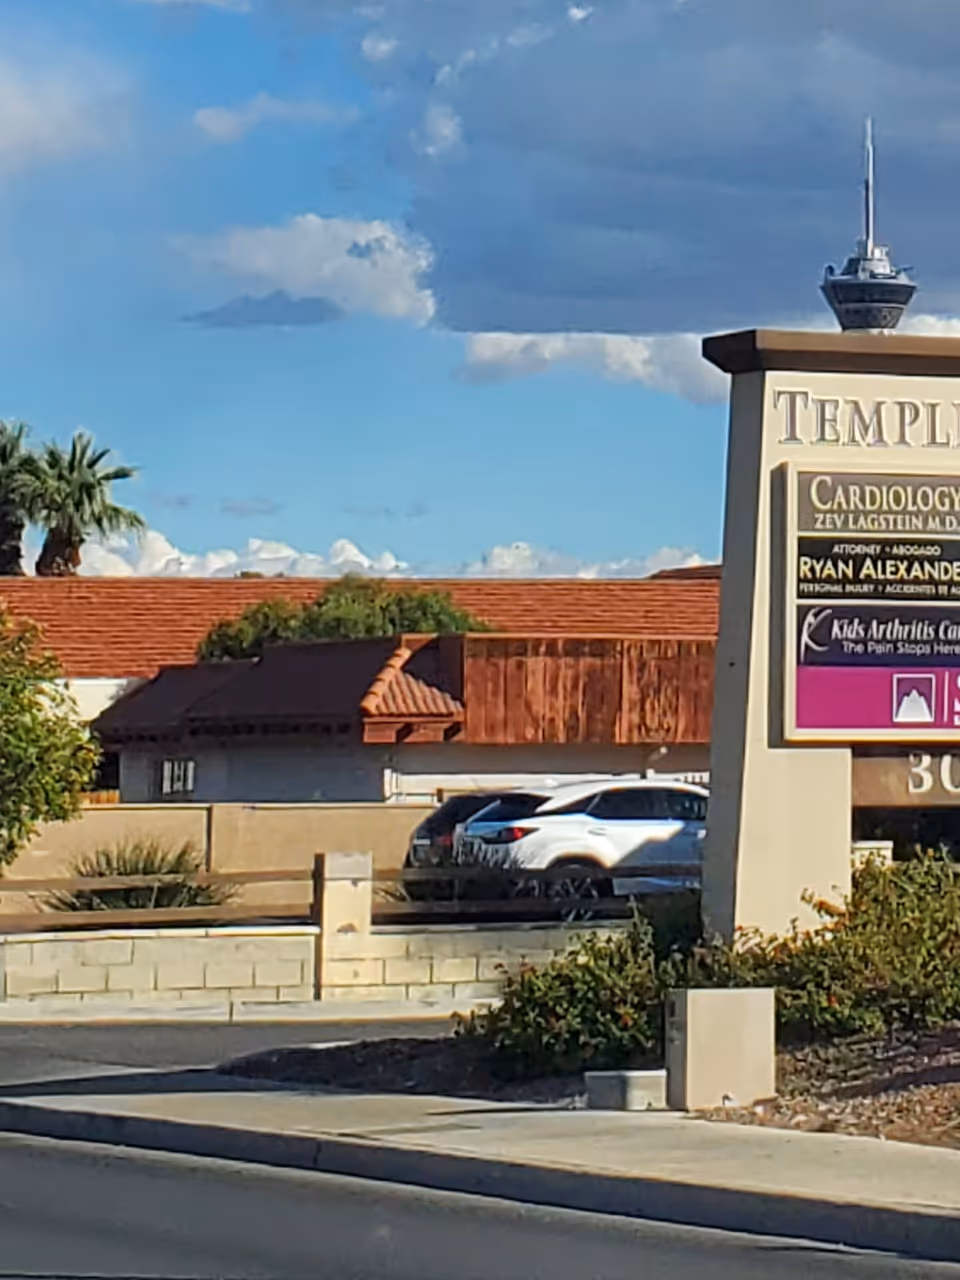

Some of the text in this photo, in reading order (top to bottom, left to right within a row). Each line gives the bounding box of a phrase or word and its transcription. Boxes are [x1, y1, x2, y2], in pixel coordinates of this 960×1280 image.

[814, 513, 845, 530] ZEV
[848, 513, 923, 531] LAGSTEIN
[831, 544, 881, 555] ATTORNEY
[799, 556, 853, 580] RYAN
[831, 618, 866, 641] Kids
[867, 617, 936, 642] Arthritis
[843, 641, 865, 655] The
[867, 640, 895, 656] Pain
[896, 641, 932, 658] Stops
